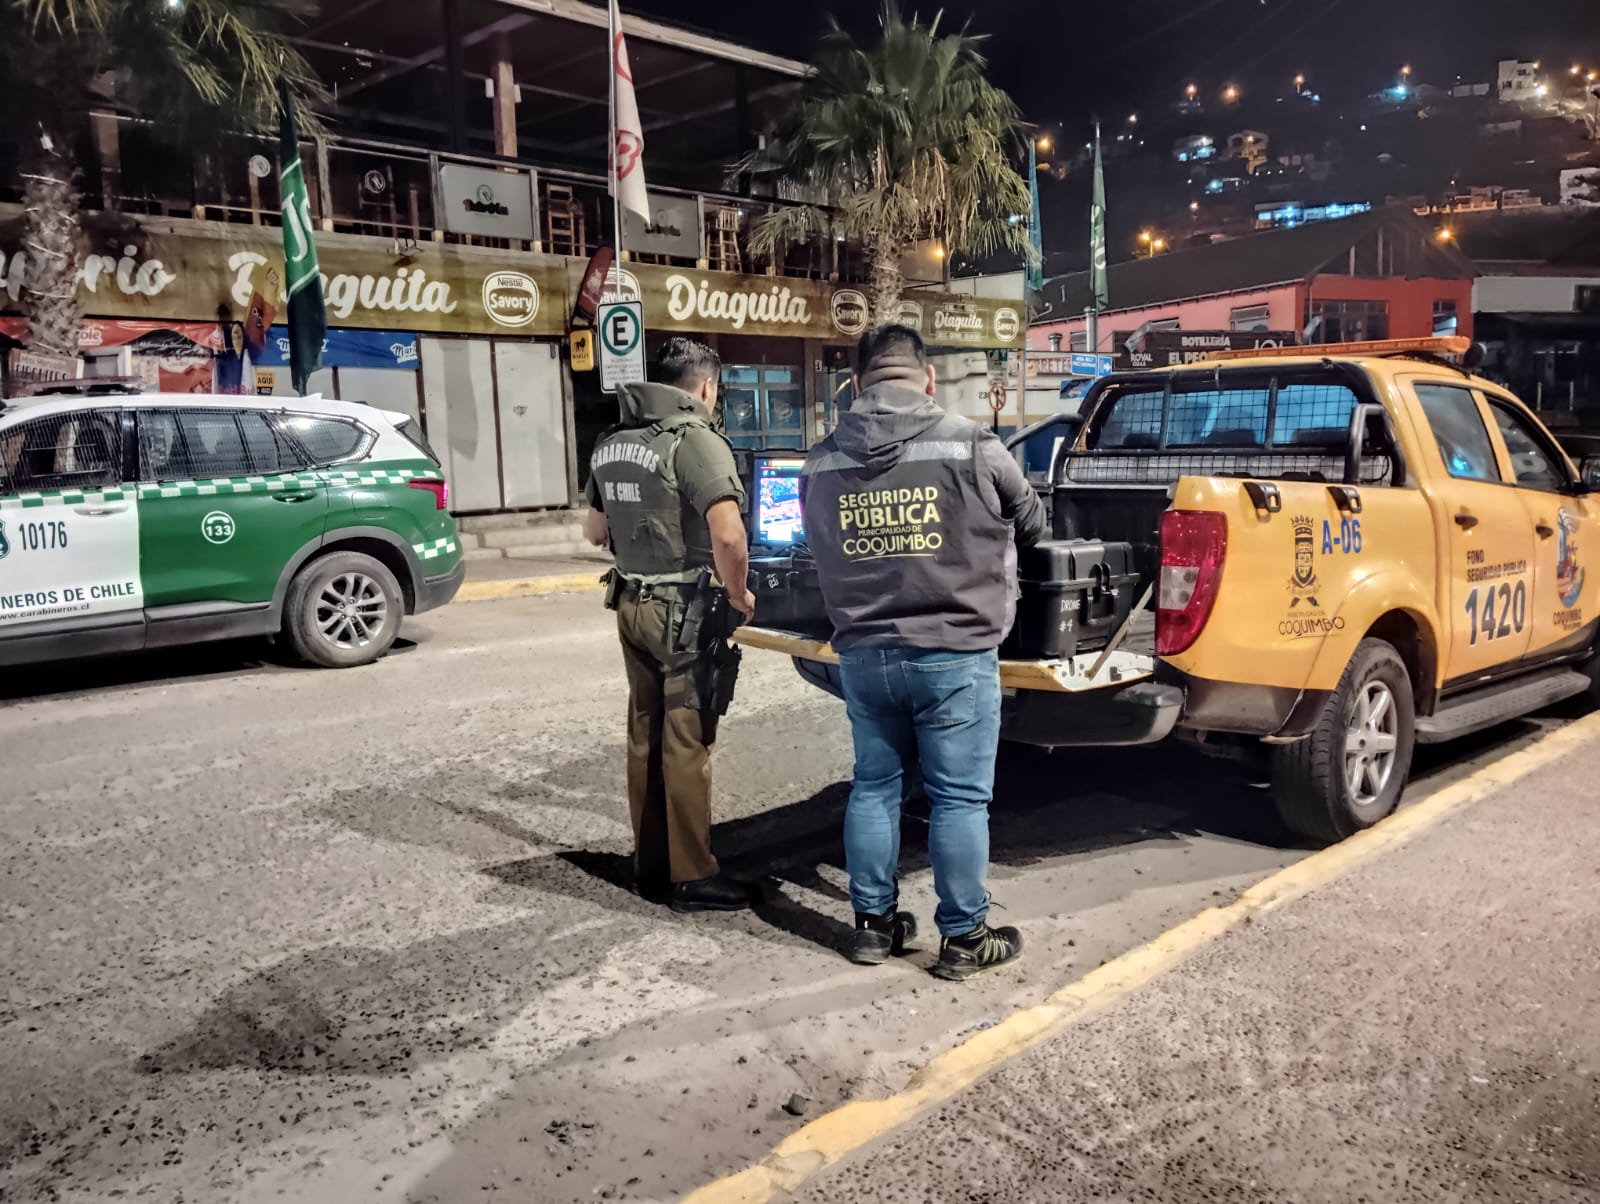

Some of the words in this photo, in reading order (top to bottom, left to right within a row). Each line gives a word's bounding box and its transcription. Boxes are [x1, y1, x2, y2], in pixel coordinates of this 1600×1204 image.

[490, 292, 533, 313] Savory
[665, 274, 812, 329] Diaguita
[836, 306, 863, 323] Savory
[934, 309, 984, 332] Diaguita
[613, 315, 629, 347] E
[1181, 334, 1231, 347] BOTILLERÍA
[1130, 352, 1153, 362] ROYAL
[1168, 352, 1182, 365] EL
[591, 442, 660, 473] CARABINEROS
[604, 481, 615, 501] DE
[617, 482, 641, 502] CHILE
[838, 486, 939, 509] SEGURIDAD
[839, 502, 941, 531] PÚBLICA
[19, 520, 68, 551] 10176
[205, 525, 233, 537] 133
[857, 525, 911, 537] MUNICIPALIDAD
[911, 524, 923, 533] DE
[1321, 518, 1363, 555] A-06
[842, 532, 943, 556] COQUIMBO
[64, 586, 86, 602] DE
[90, 581, 136, 599] CHILE
[1464, 579, 1526, 646] 1420
[1278, 615, 1346, 637] COQUIMBO
